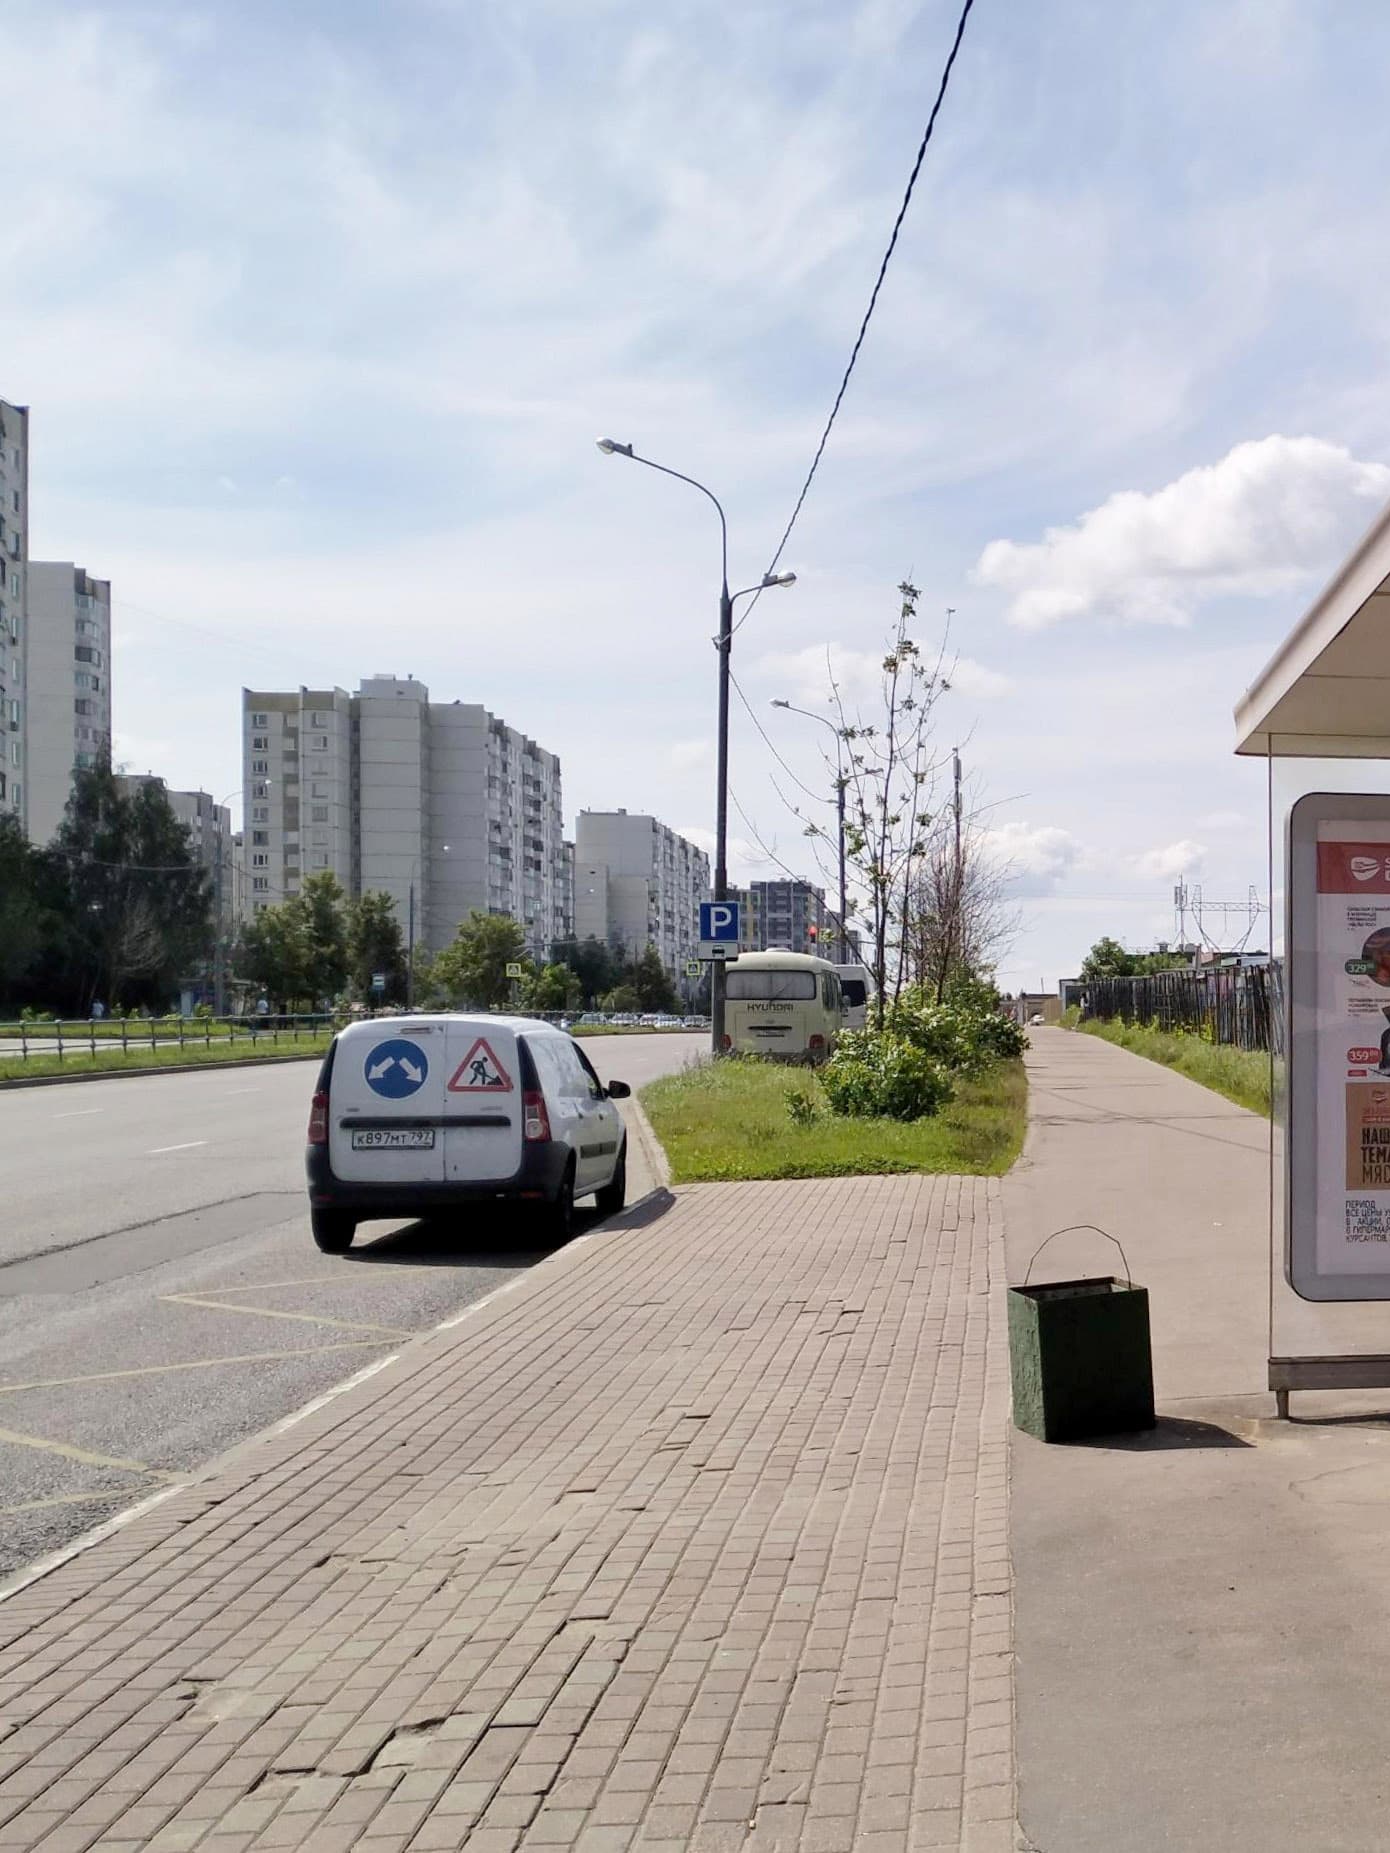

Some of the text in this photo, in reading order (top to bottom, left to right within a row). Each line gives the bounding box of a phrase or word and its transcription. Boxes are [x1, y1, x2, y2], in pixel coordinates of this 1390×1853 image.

[747, 1003, 793, 1012] HYUNDAI
[1349, 1050, 1369, 1061] 359
[1345, 1208, 1360, 1216] ВСЕ
